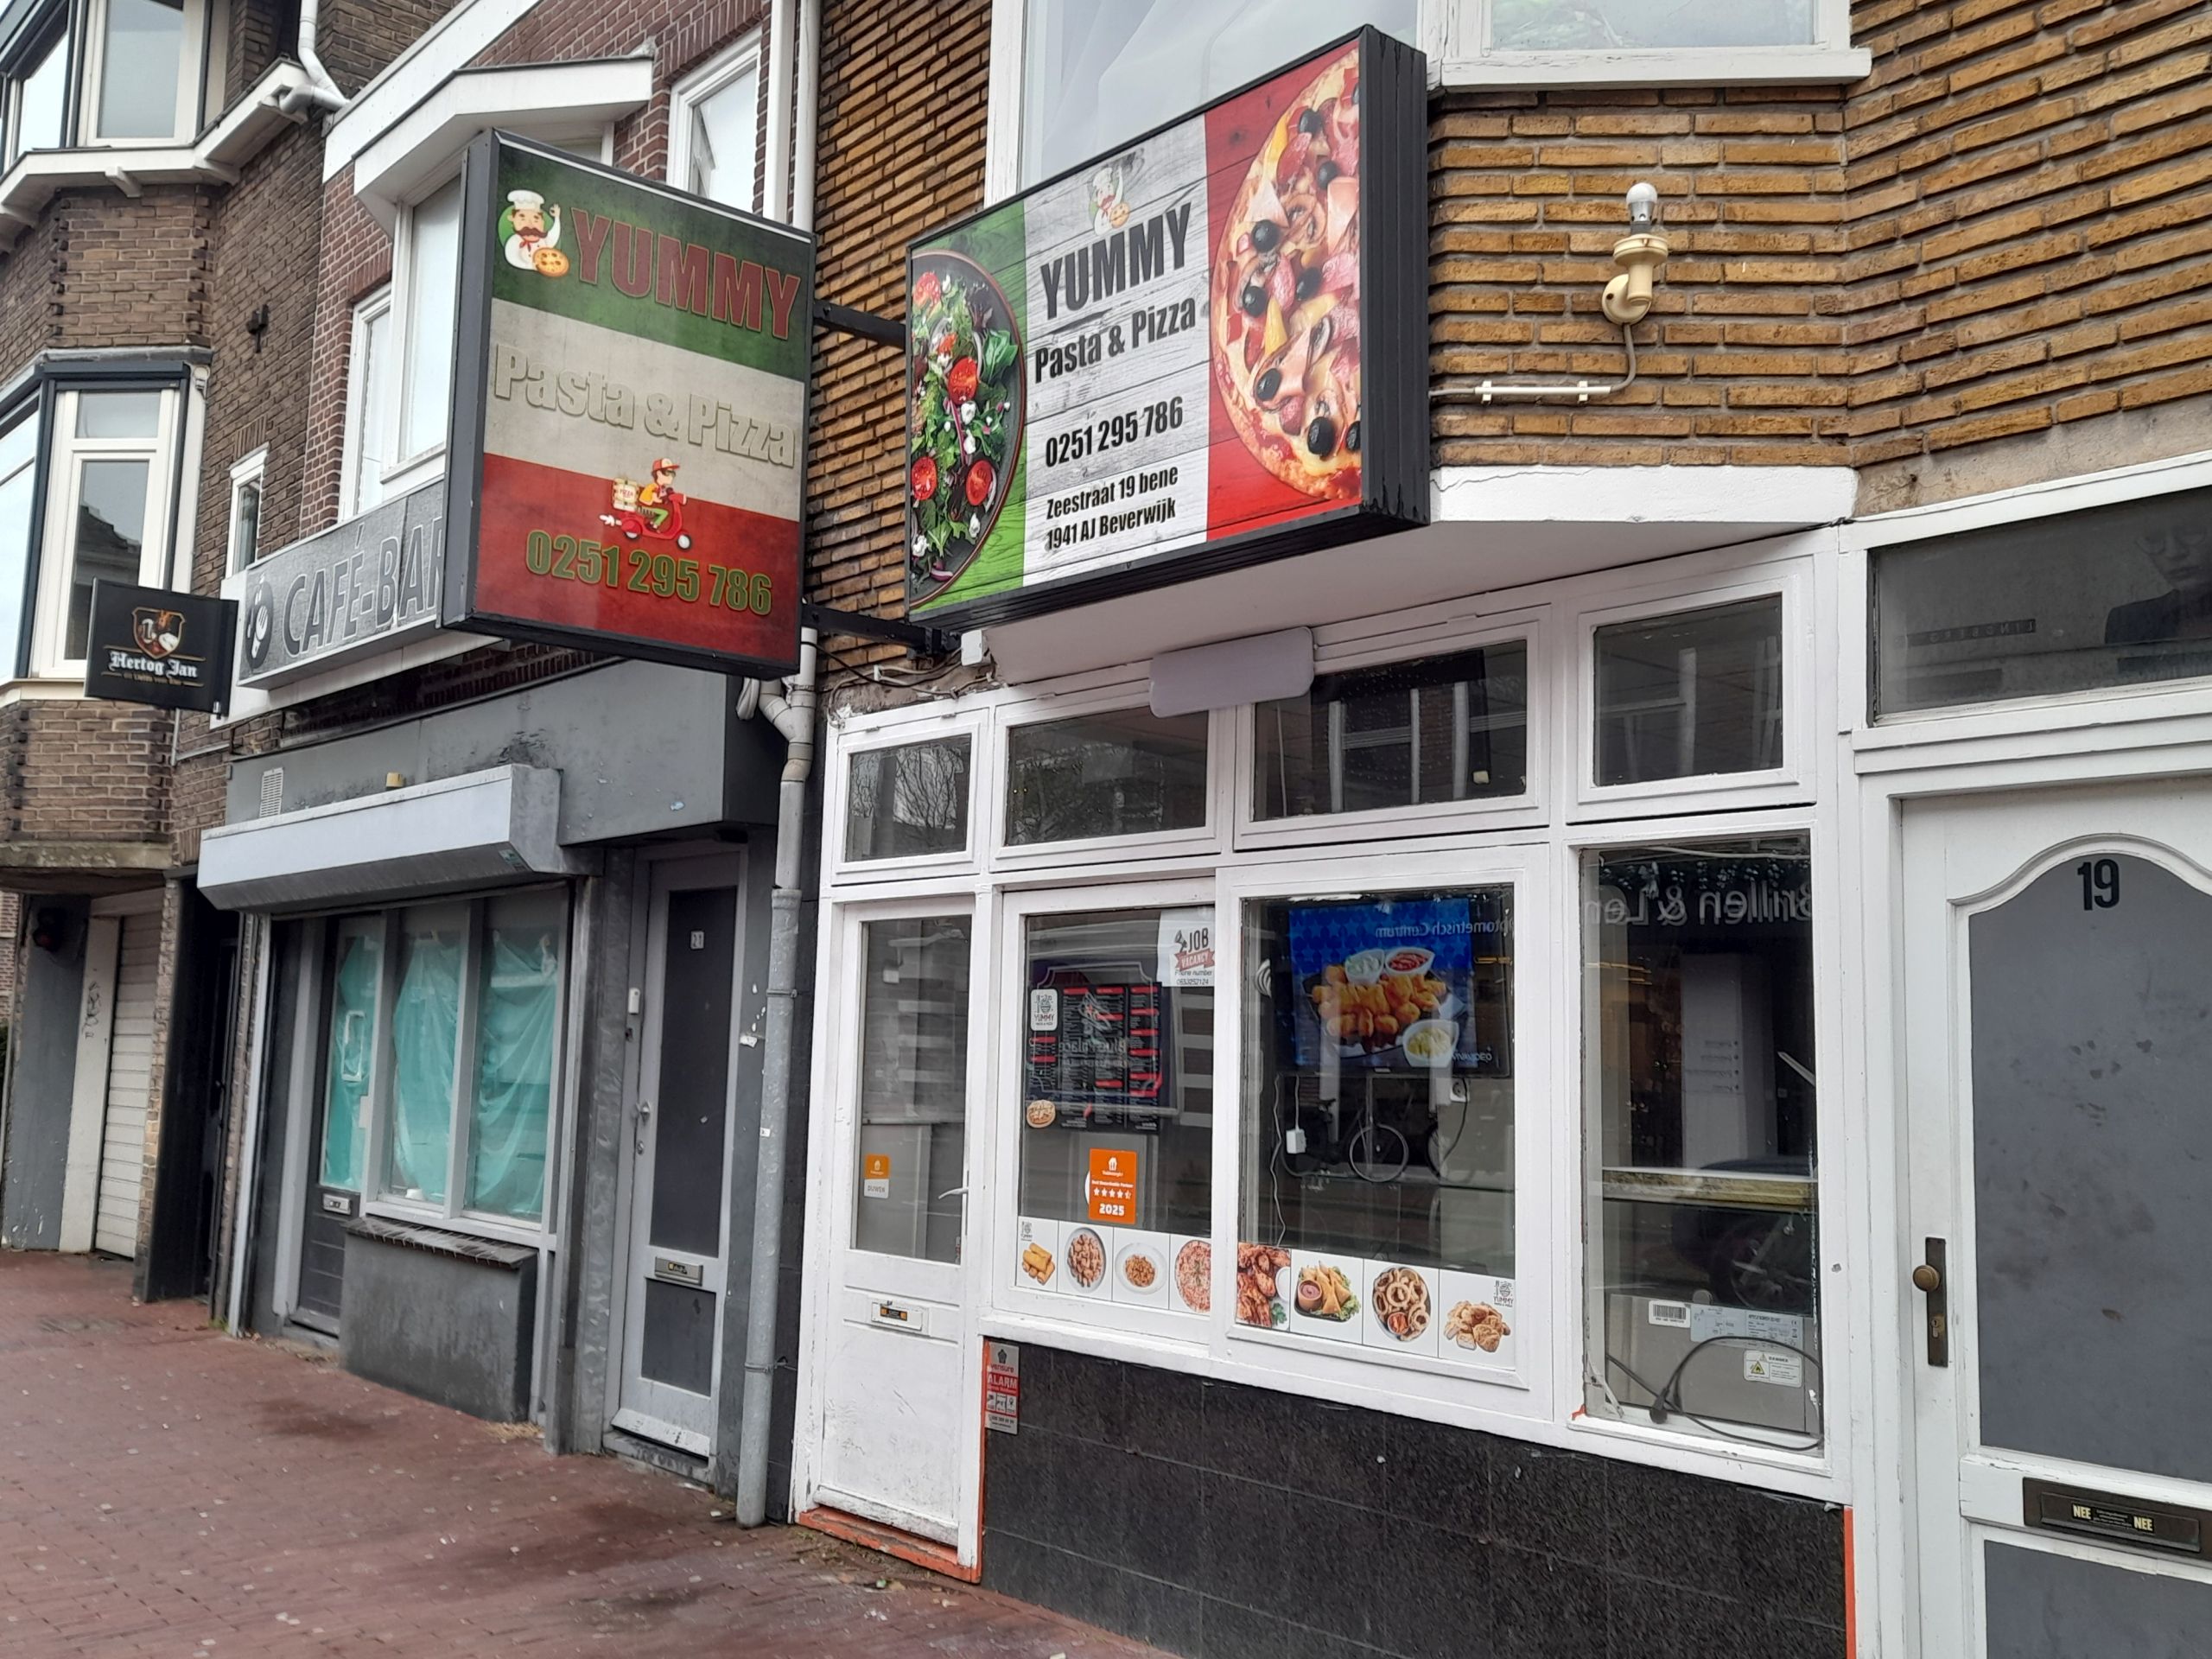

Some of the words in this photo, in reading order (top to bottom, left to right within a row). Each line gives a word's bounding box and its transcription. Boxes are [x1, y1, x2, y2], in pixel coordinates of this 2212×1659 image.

[571, 207, 801, 340] YUMMY
[1040, 201, 1191, 320] YUMMY
[1034, 321, 1102, 384] Pasta
[1108, 324, 1125, 355] &
[1132, 296, 1196, 349] Pizza
[494, 343, 635, 430] Pasta
[644, 391, 679, 442] &
[687, 394, 796, 468] Pizza
[1046, 424, 1093, 468] 0251
[1096, 410, 1138, 454] 295
[1142, 395, 1184, 439] 786
[1046, 484, 1118, 520] Zeestraat
[1118, 479, 1137, 504] 19
[1139, 465, 1179, 499] bene
[1046, 520, 1078, 551] 1941
[1079, 518, 1097, 543] AJ
[1098, 499, 1178, 537] Beverwijk
[526, 530, 620, 588] 0251
[628, 550, 702, 602] 295
[708, 565, 773, 615] 786
[108, 651, 165, 676] Hertog
[166, 659, 198, 679] Jan
[2077, 859, 2120, 911] 19
[1181, 954, 1209, 969] VACANCY
[1188, 927, 1209, 953] JOB
[1099, 1204, 1124, 1216] 2025
[987, 1374, 1017, 1389] ALARM
[2072, 1504, 2092, 1519] NEE
[2133, 1516, 2153, 1531] NEE
